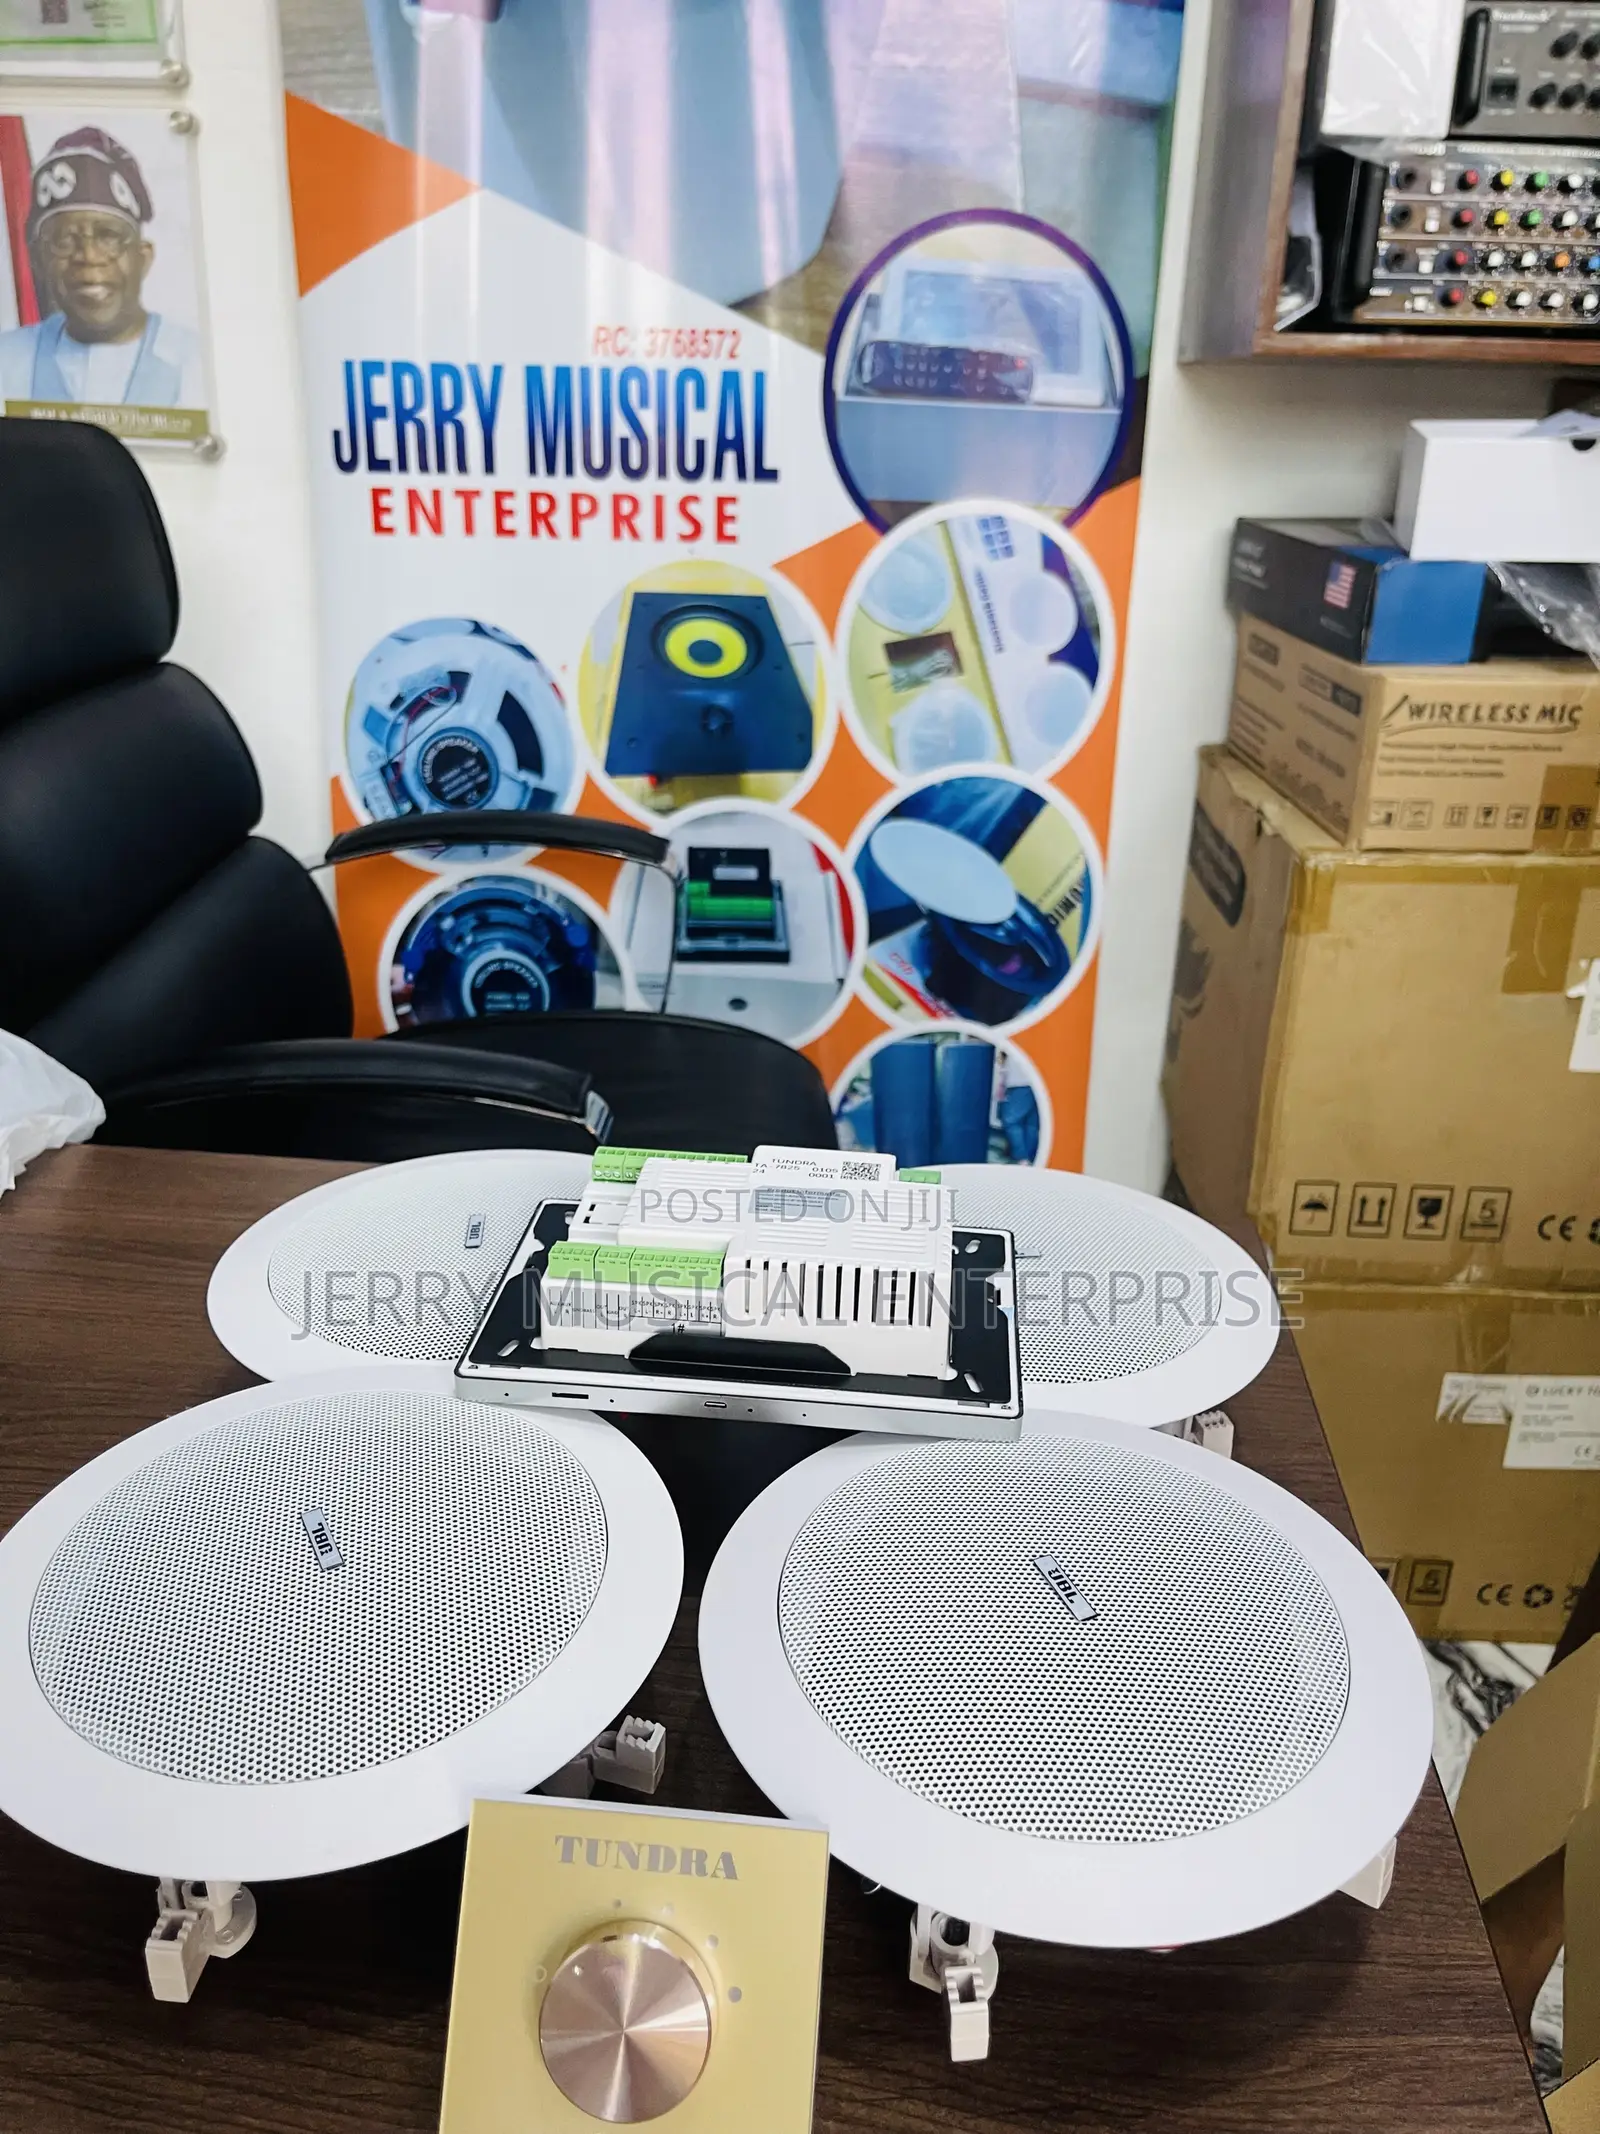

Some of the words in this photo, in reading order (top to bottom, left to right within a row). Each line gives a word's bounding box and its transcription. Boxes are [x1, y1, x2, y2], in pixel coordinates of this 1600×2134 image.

[644, 328, 742, 359] 3768572
[333, 359, 503, 475] JERRY
[525, 364, 779, 482] MUSICAL
[370, 487, 739, 544] ENTERPRISE
[1409, 703, 1531, 723] WIRELESS
[1535, 703, 1584, 727] MIC
[772, 1158, 817, 1166] TUNDRA
[812, 1166, 838, 1174] 0105
[555, 1835, 739, 1880] TUNDRA
